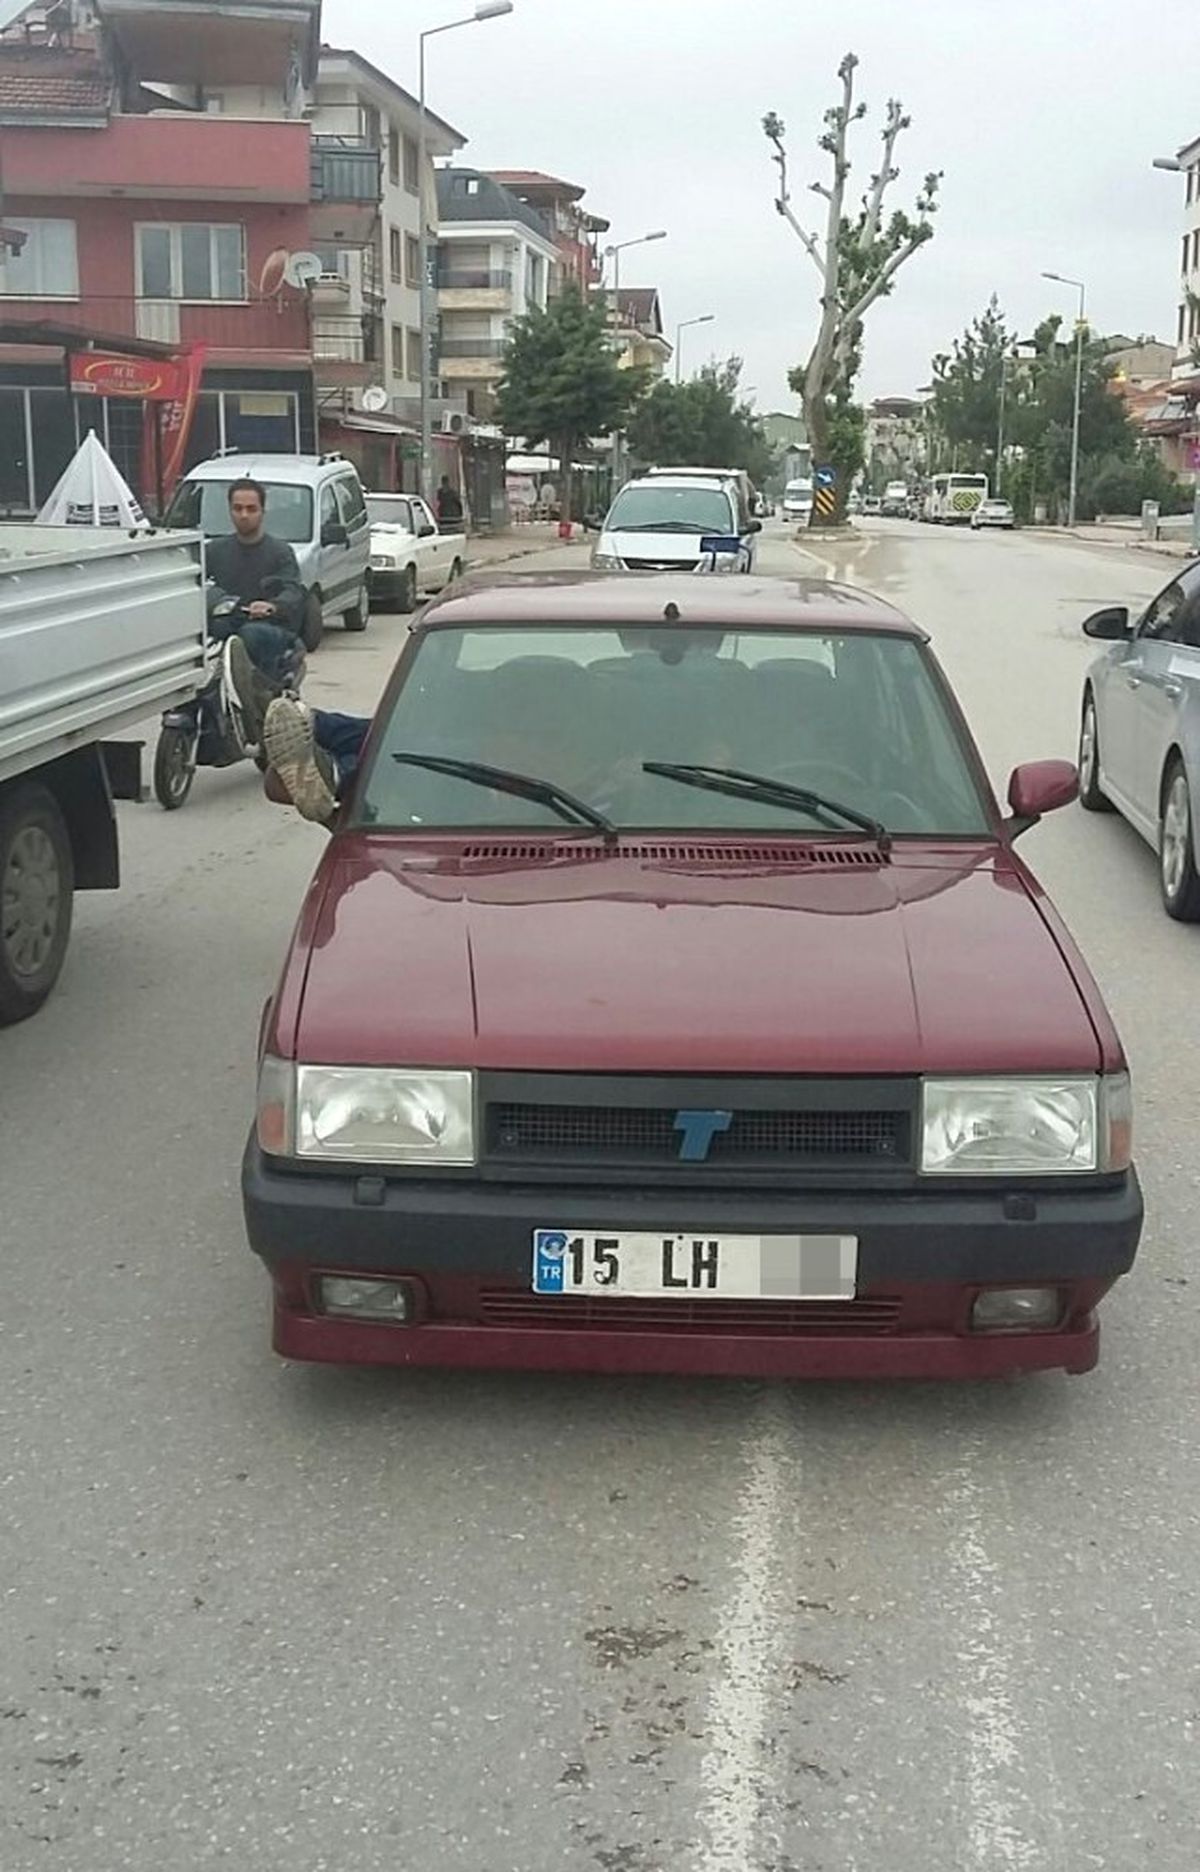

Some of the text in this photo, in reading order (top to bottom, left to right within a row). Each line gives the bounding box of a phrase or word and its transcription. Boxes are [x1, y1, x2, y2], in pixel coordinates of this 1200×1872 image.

[673, 1110, 733, 1161] T
[541, 1265, 561, 1280] TR
[568, 1237, 718, 1288] 15 LH
